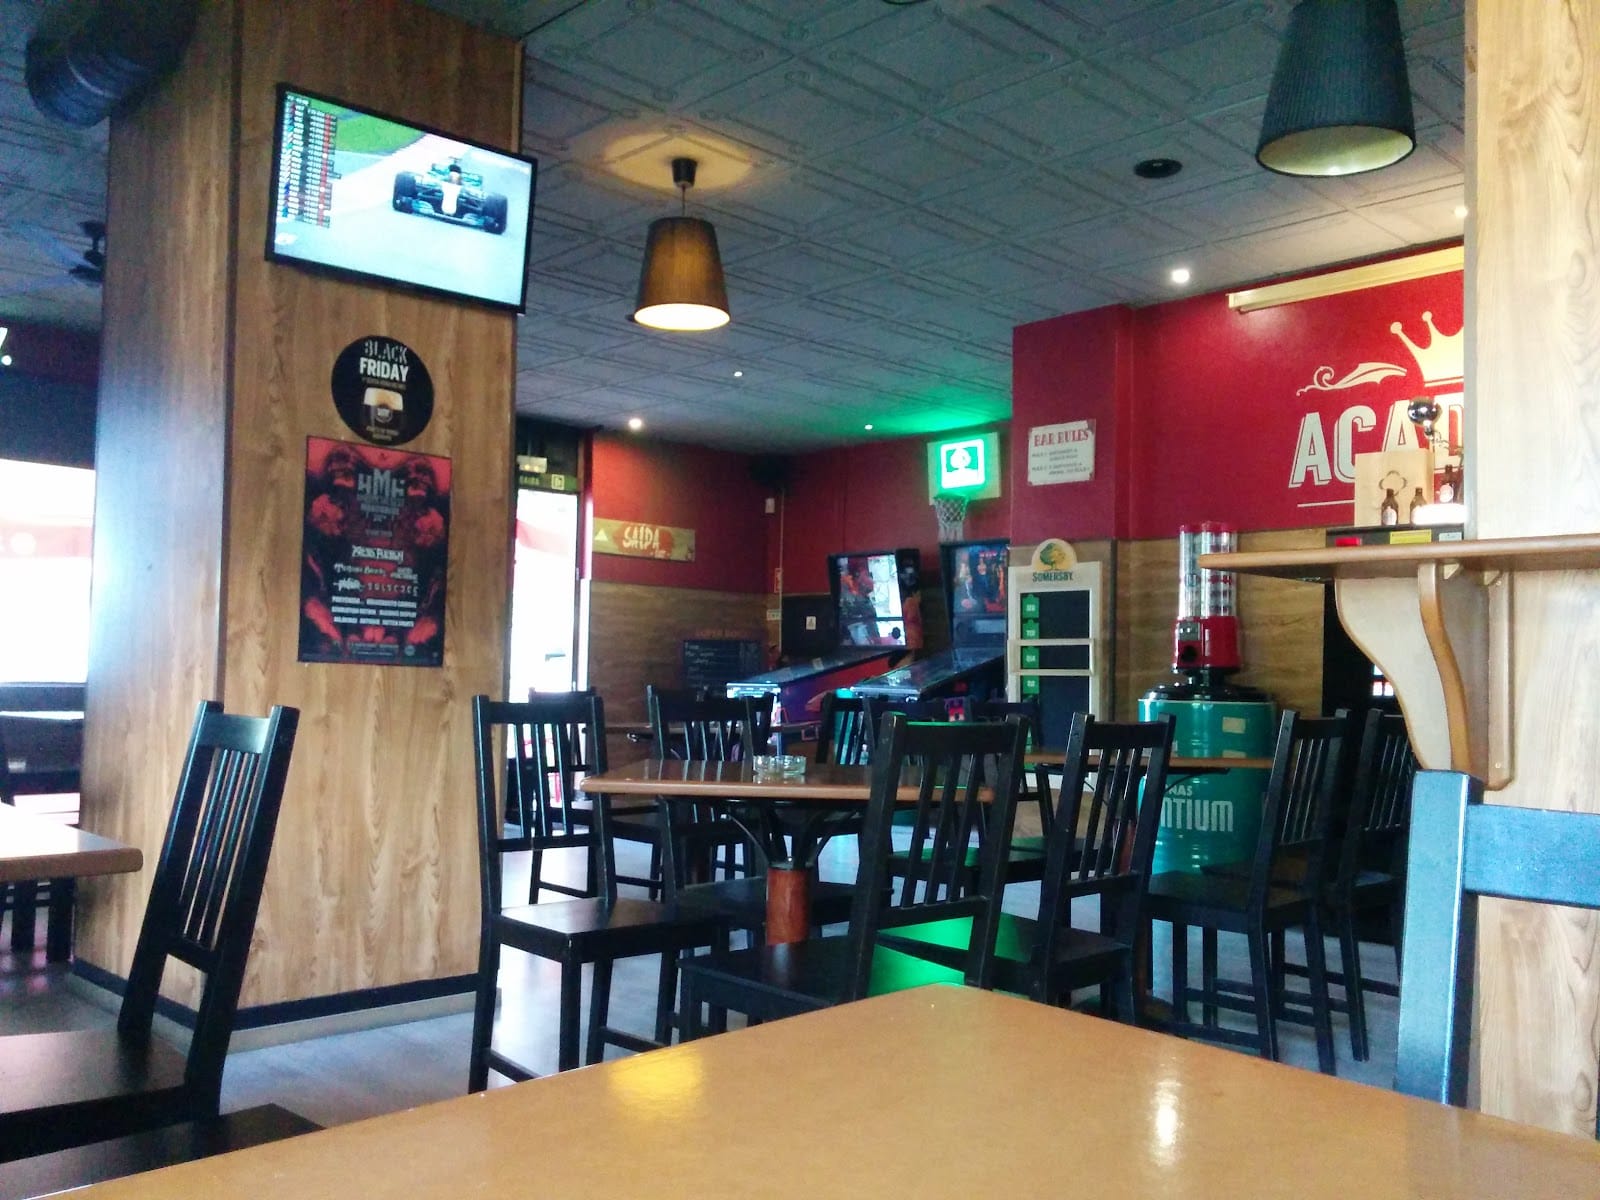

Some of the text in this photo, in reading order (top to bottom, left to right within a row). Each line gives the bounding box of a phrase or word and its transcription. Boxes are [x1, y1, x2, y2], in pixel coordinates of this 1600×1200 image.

[364, 339, 408, 364] BLACK
[359, 356, 409, 382] FRIDAY
[1034, 429, 1089, 447] BAR RULES
[1032, 571, 1073, 583] SOMERSBY
